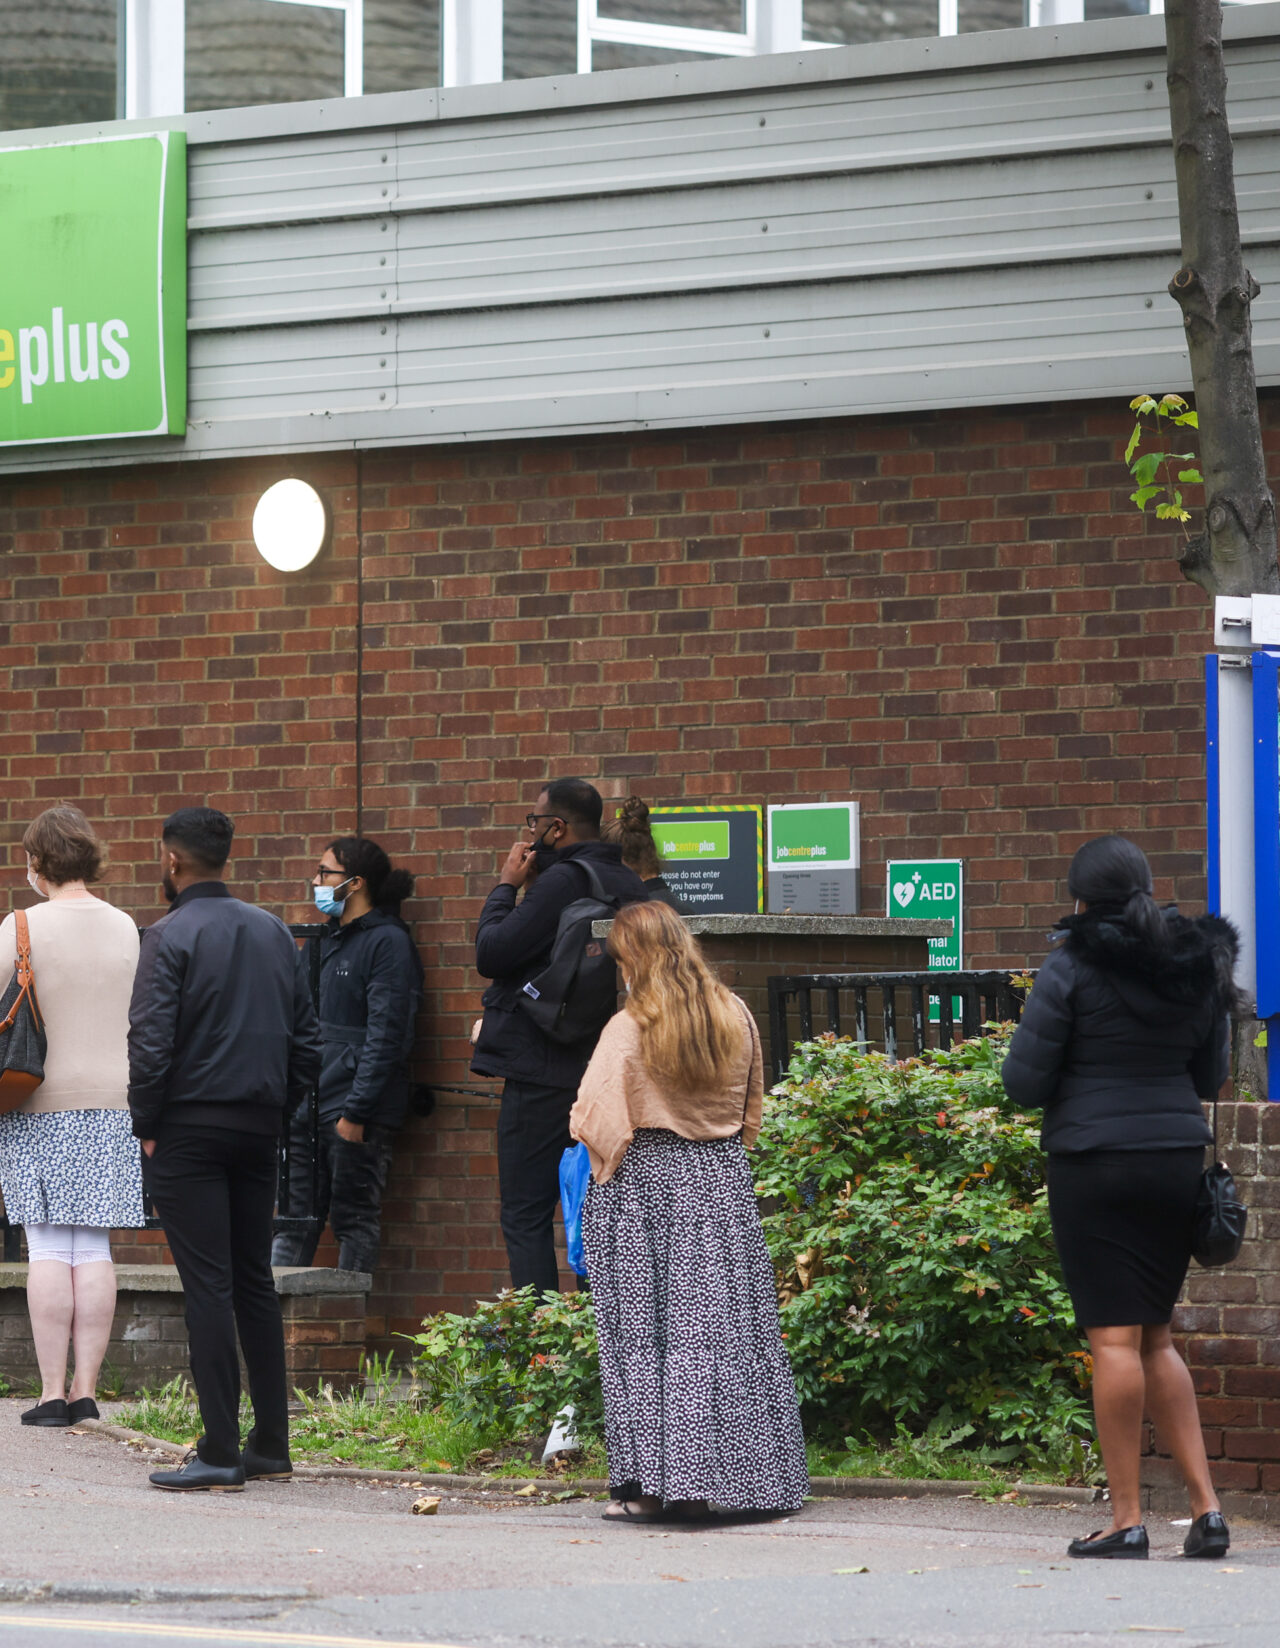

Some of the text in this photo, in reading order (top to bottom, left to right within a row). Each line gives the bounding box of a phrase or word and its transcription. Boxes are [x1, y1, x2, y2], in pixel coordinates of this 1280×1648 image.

[663, 840, 716, 855] jobcentreplus
[776, 844, 827, 859] jobcentreplus
[659, 870, 721, 880] lease do not enter
[670, 882, 683, 892] you
[684, 881, 700, 890] have
[701, 882, 714, 892] any
[918, 882, 956, 901] AED
[689, 893, 724, 903] symptoms
[928, 953, 958, 967] llator
